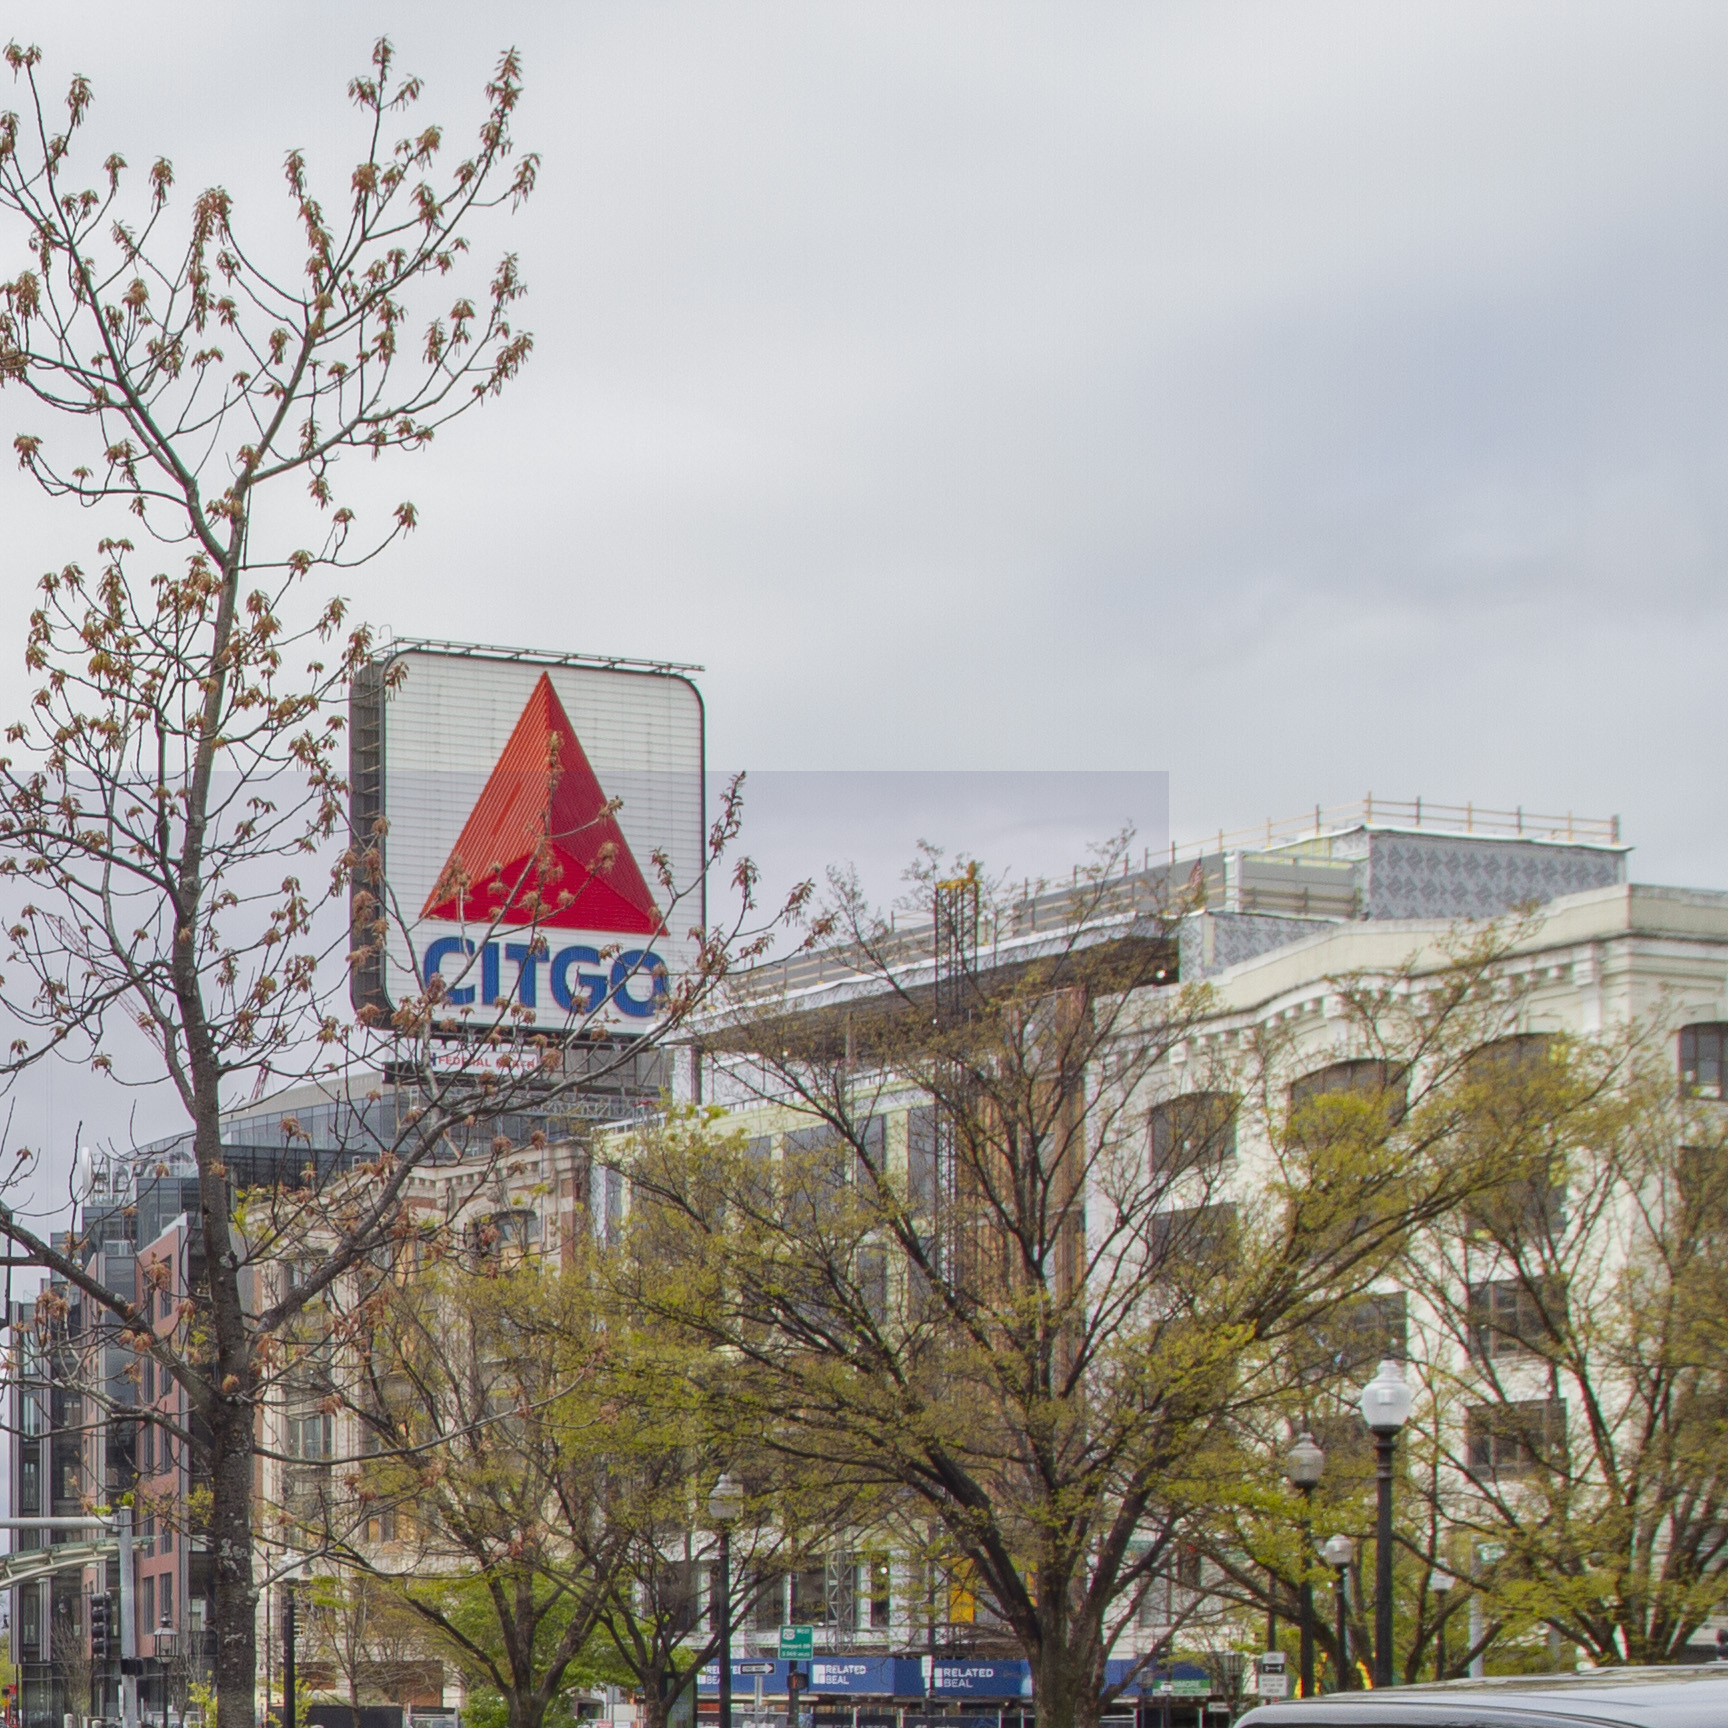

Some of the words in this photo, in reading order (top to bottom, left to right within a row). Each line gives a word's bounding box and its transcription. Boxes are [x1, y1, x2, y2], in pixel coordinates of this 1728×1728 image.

[423, 936, 670, 1017] CITGO
[826, 1664, 866, 1674] RELATED
[943, 1668, 994, 1678] RELATED
[826, 1675, 849, 1684] BEAL
[943, 1678, 973, 1688] BEAL
